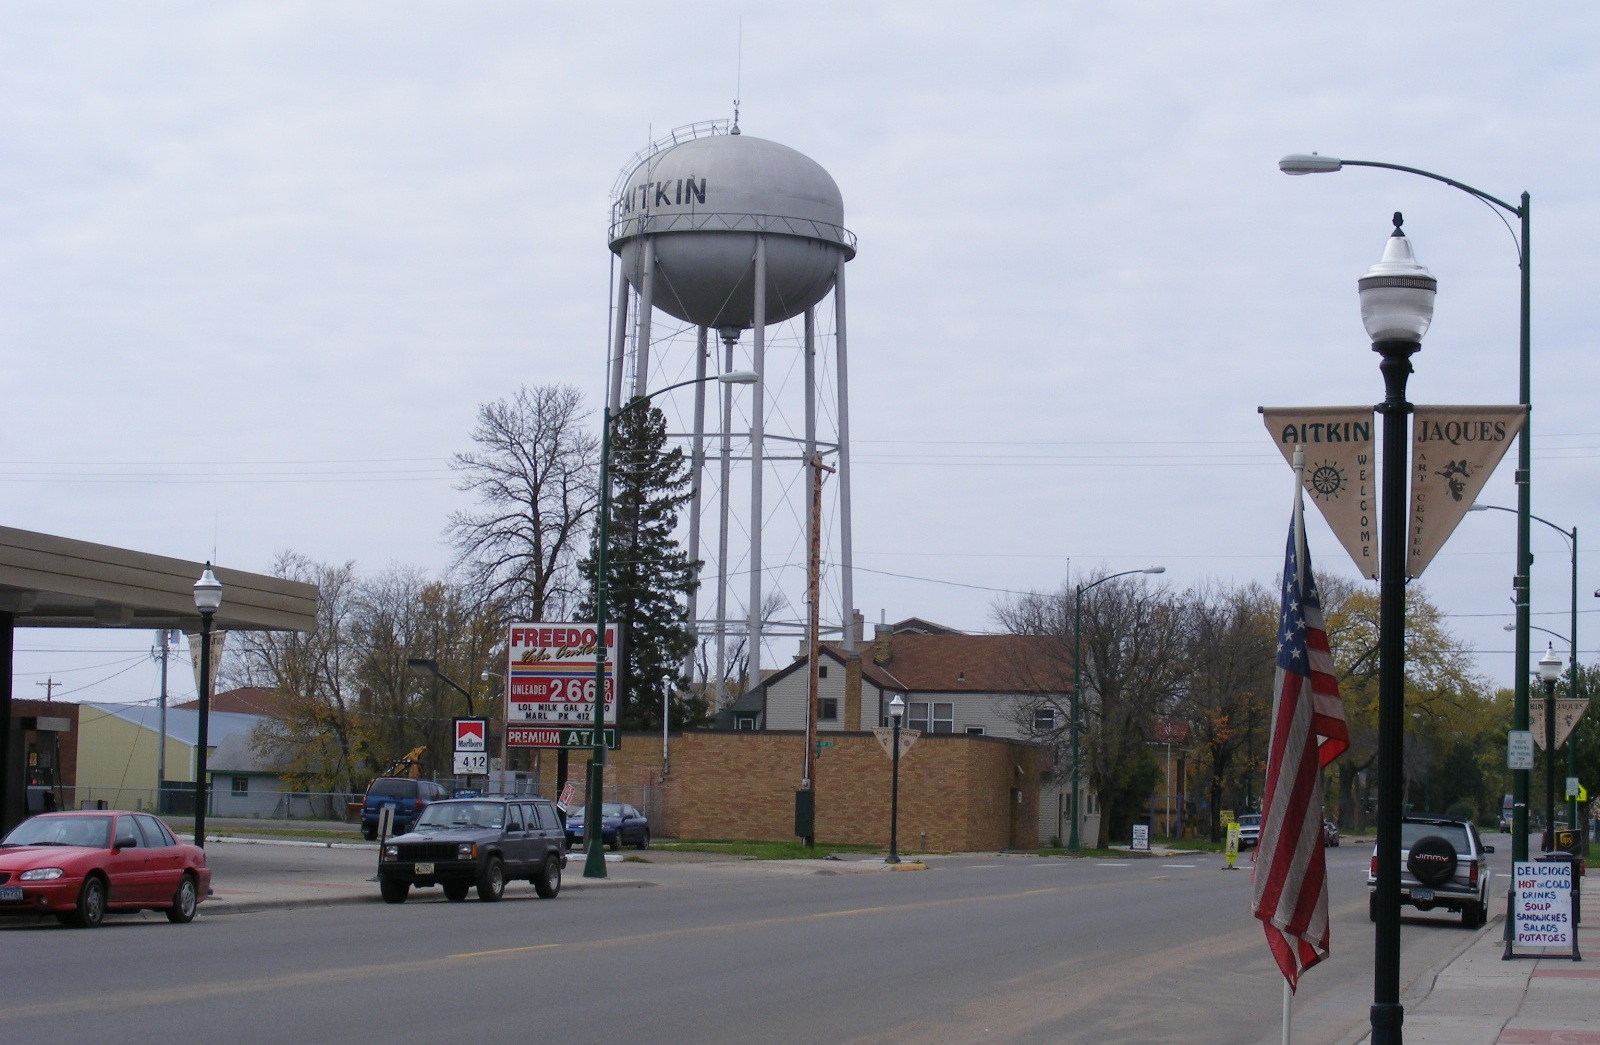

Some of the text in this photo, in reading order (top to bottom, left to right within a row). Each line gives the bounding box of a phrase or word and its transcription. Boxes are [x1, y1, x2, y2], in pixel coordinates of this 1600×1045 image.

[623, 178, 706, 215] AITKIN
[1281, 421, 1369, 443] AITKIN
[1418, 421, 1506, 445] JAQUES
[1357, 454, 1370, 556] WELCOME
[1412, 453, 1427, 556] ART CENTER
[511, 628, 614, 648] FREEDOM
[512, 684, 547, 695] UNLEADED
[518, 703, 532, 711] LOL
[538, 703, 557, 711] MILK
[563, 704, 579, 712] GAL
[526, 712, 590, 720] MARL PK 412
[508, 731, 560, 744] PREMIUM
[458, 738, 482, 748] Marlboro
[1517, 866, 1570, 876] DELICIOUS
[1518, 880, 1536, 888] HOT
[1546, 880, 1570, 888] COLD
[1522, 891, 1556, 899] DRINKS
[1524, 902, 1551, 911] SOUP
[1516, 913, 1568, 922] SANDWICHES
[1523, 923, 1559, 932] SALADS
[1518, 933, 1567, 942] POTATOES
